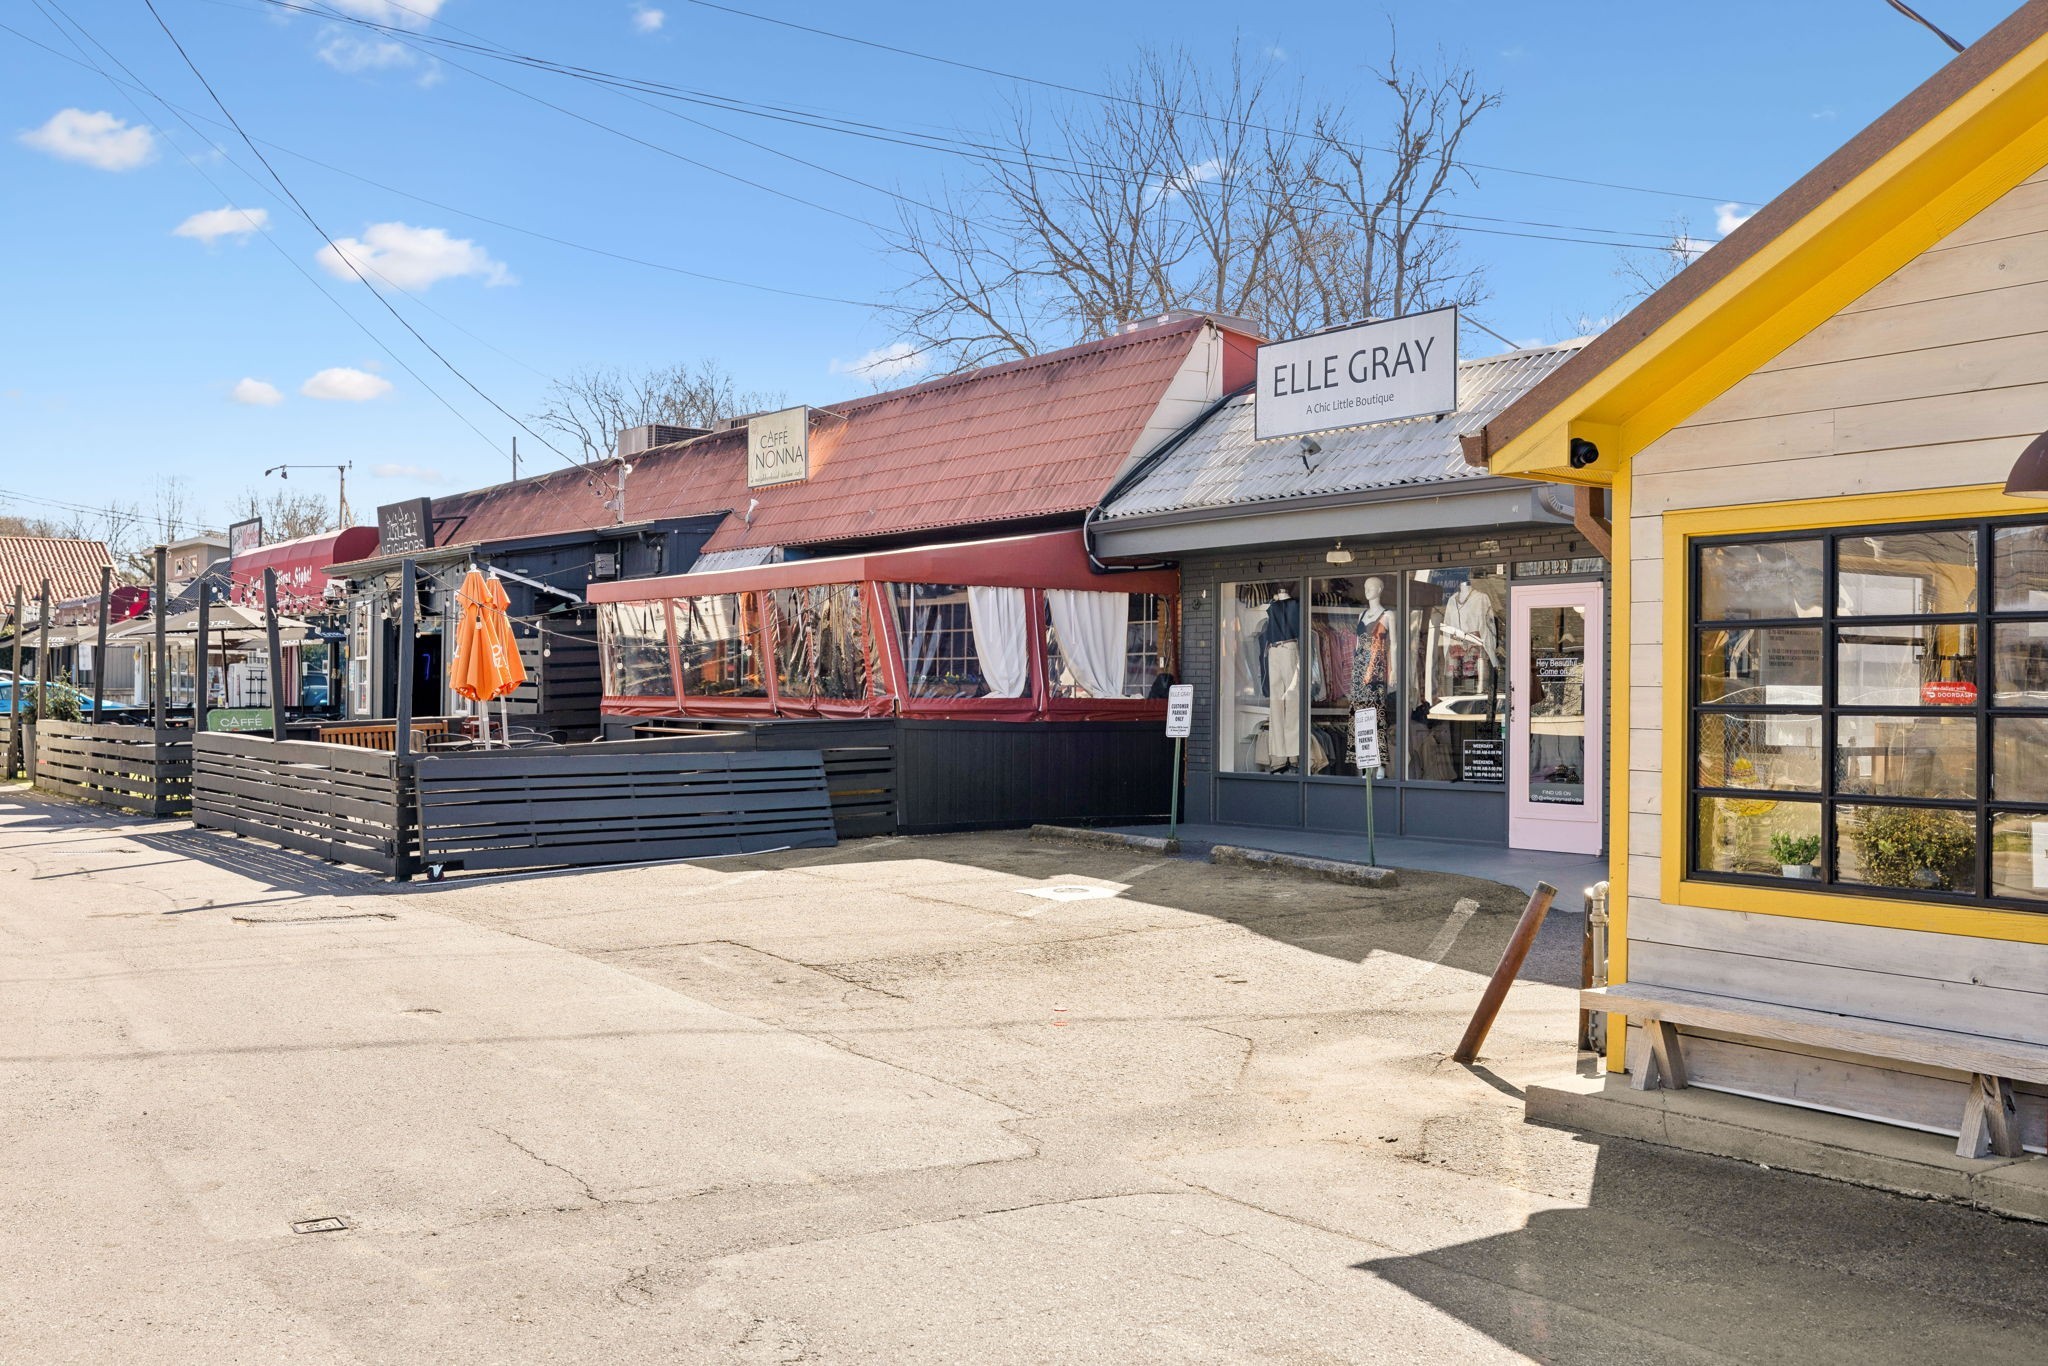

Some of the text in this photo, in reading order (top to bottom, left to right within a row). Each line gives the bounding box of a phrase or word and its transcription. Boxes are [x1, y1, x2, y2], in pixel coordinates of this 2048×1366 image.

[1274, 336, 1435, 397] ELLE GRAY
[1306, 393, 1395, 415] A Chic Little Boutique
[760, 424, 788, 449] CAFFÉ
[756, 445, 804, 470] NONNA
[381, 539, 424, 556] NEIGHBORS
[1536, 660, 1549, 668] Hey
[220, 714, 262, 727] CAFFÉ
